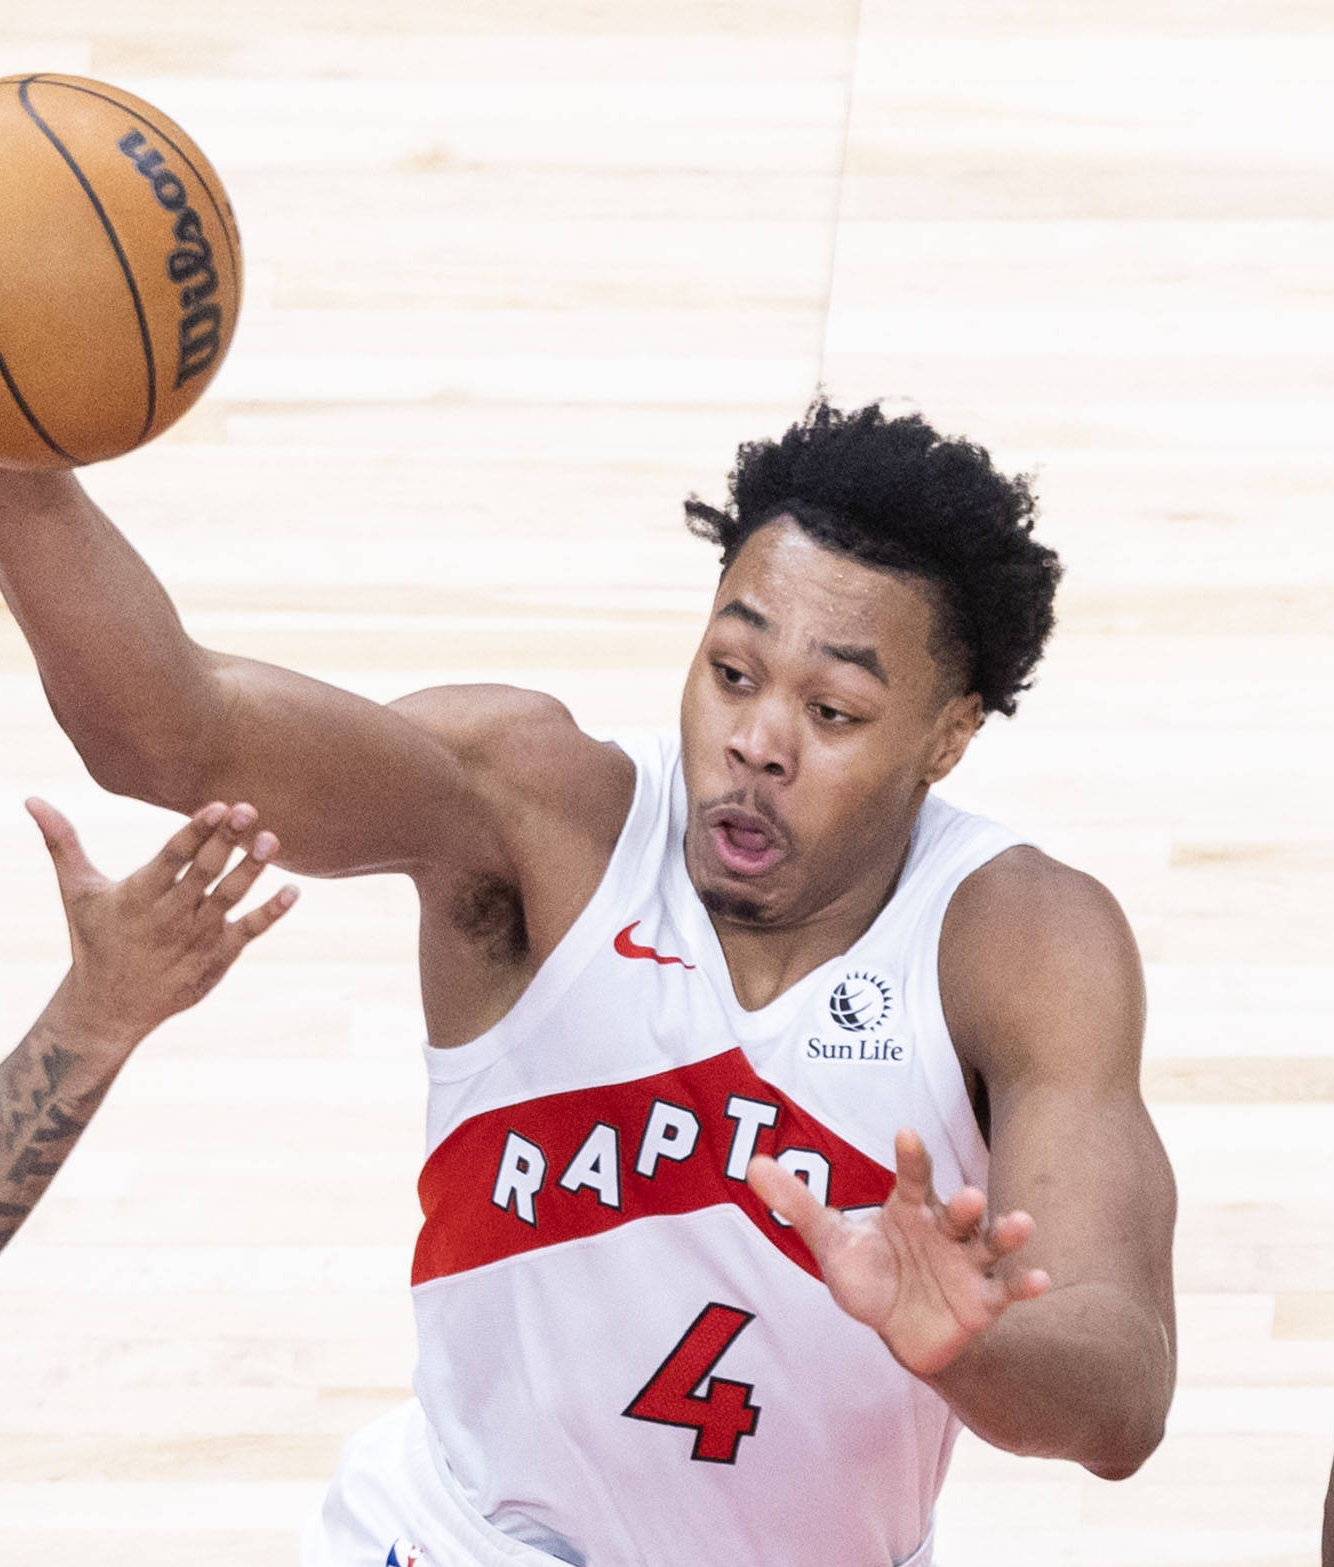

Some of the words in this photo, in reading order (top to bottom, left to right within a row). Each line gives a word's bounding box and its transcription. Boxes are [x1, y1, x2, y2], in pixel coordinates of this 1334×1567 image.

[117, 127, 223, 392] Wilson
[807, 1037, 853, 1060] Sun
[859, 1038, 904, 1062] Life
[491, 1092, 885, 1229] RAPTO
[621, 1301, 762, 1465] 4
